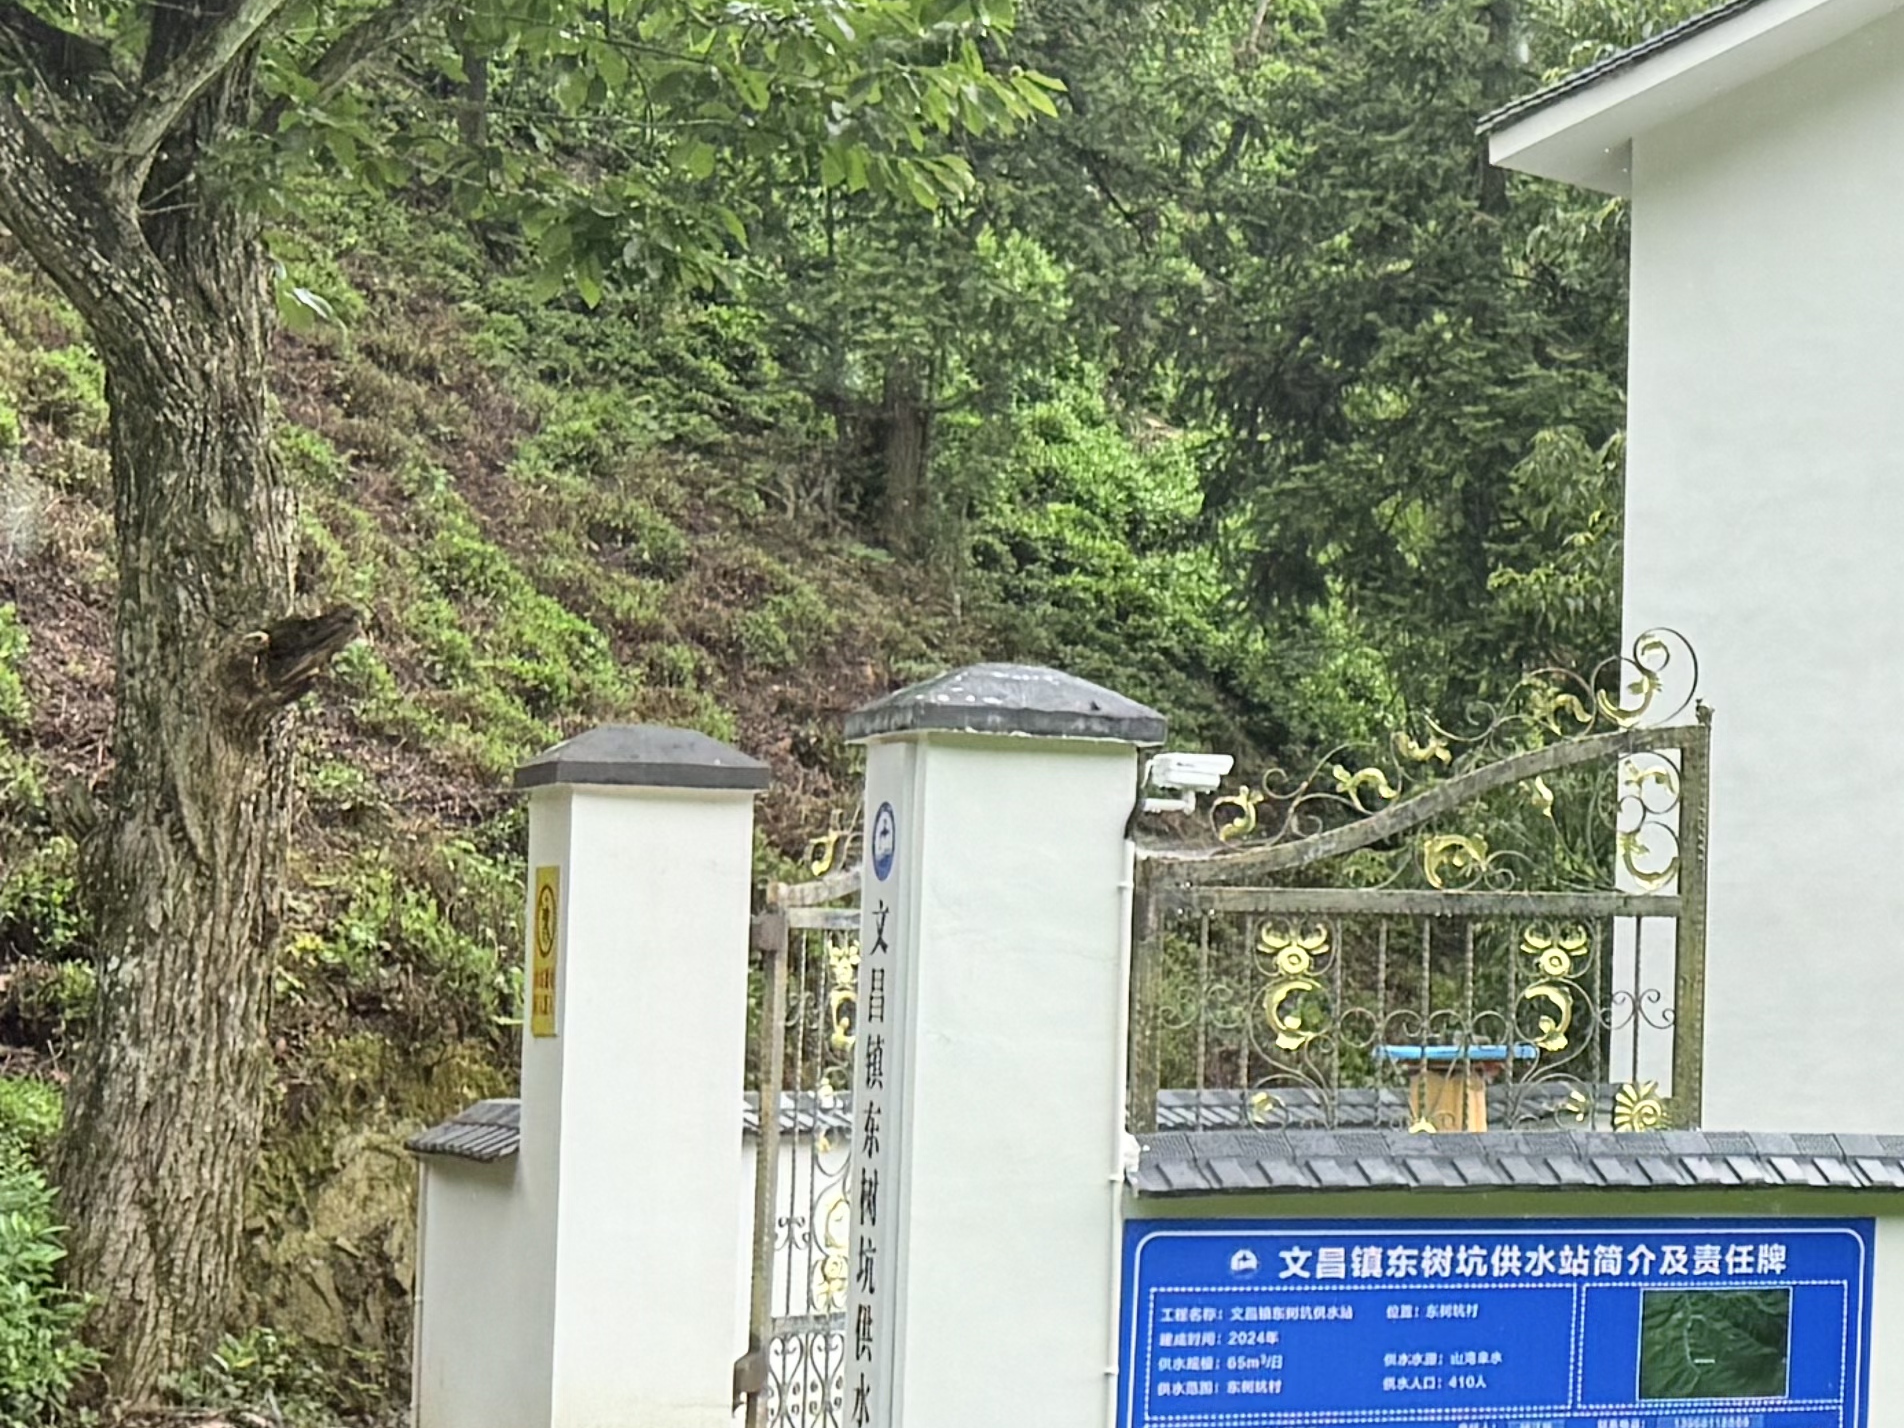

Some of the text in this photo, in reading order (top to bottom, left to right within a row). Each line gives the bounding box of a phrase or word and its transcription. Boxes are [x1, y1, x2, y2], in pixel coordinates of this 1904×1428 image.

[1278, 1243, 1787, 1279] 文昌镇东树坑供水站简介及责任牌
